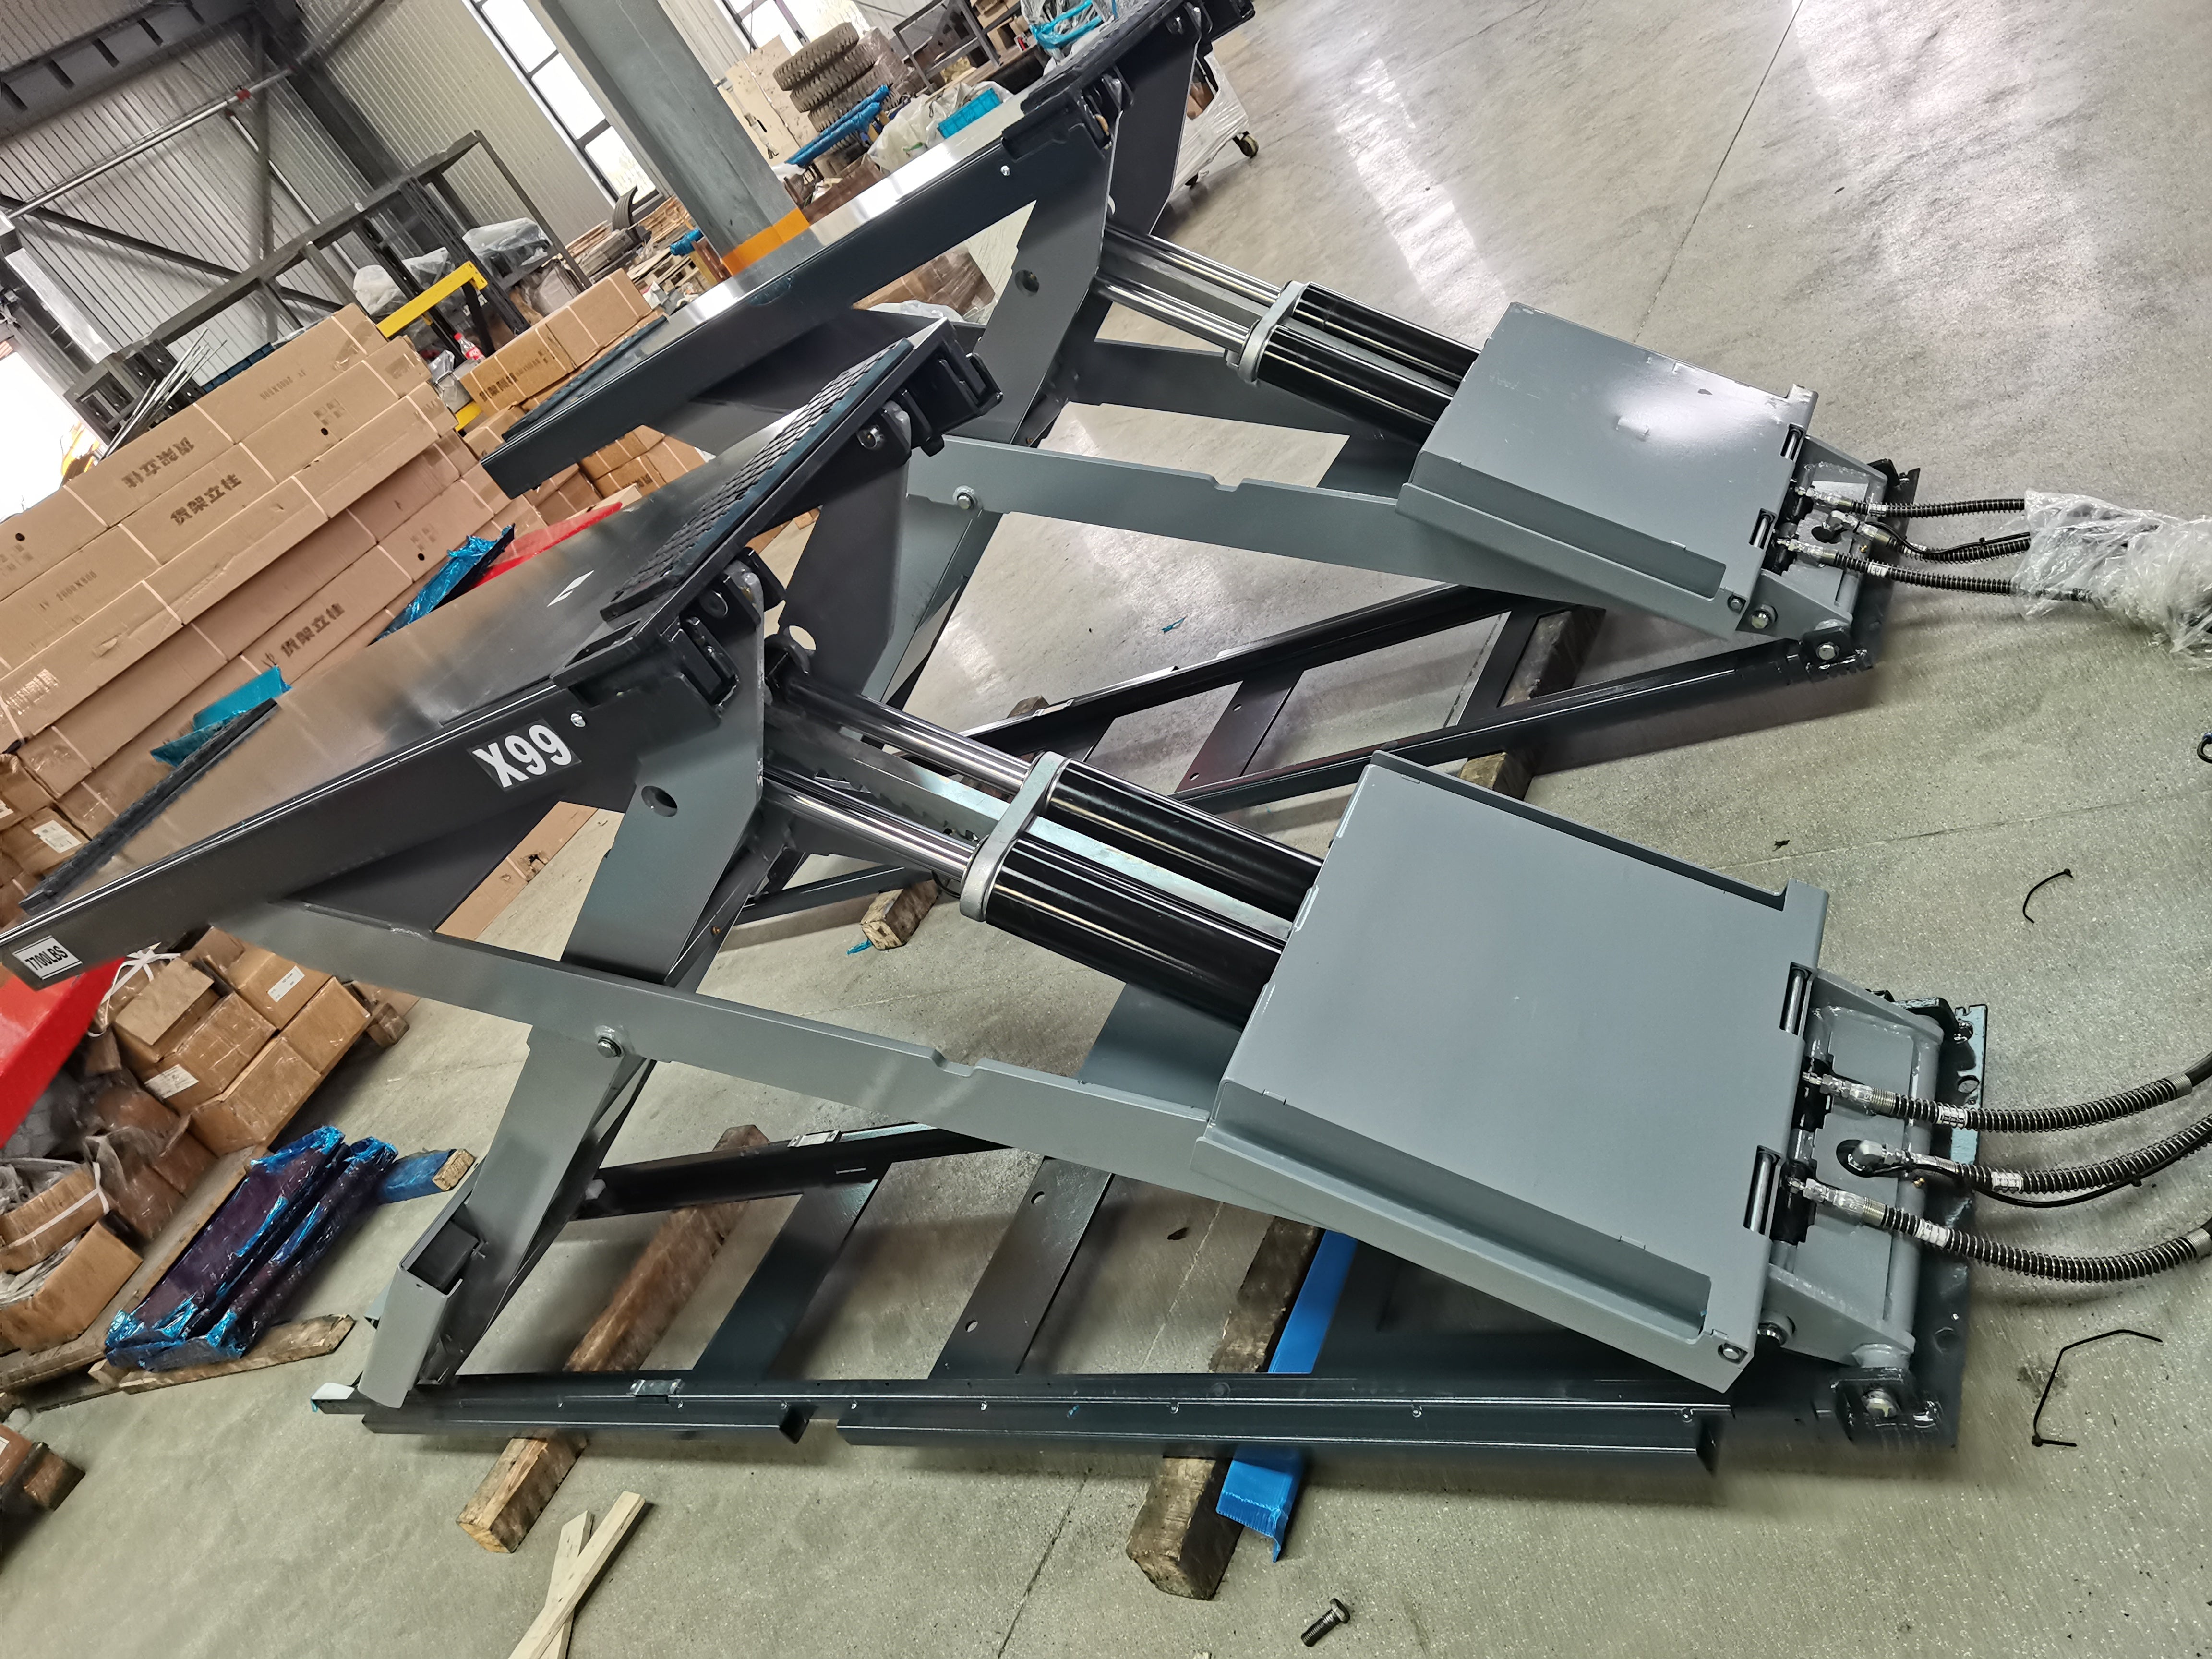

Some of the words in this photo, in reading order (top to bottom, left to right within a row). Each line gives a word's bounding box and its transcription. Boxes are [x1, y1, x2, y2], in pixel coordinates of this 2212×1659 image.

[121, 437, 194, 488] 货架立柱
[170, 473, 242, 526] 货架立柱
[472, 725, 572, 788] X99
[24, 945, 68, 971] 7700LBS
